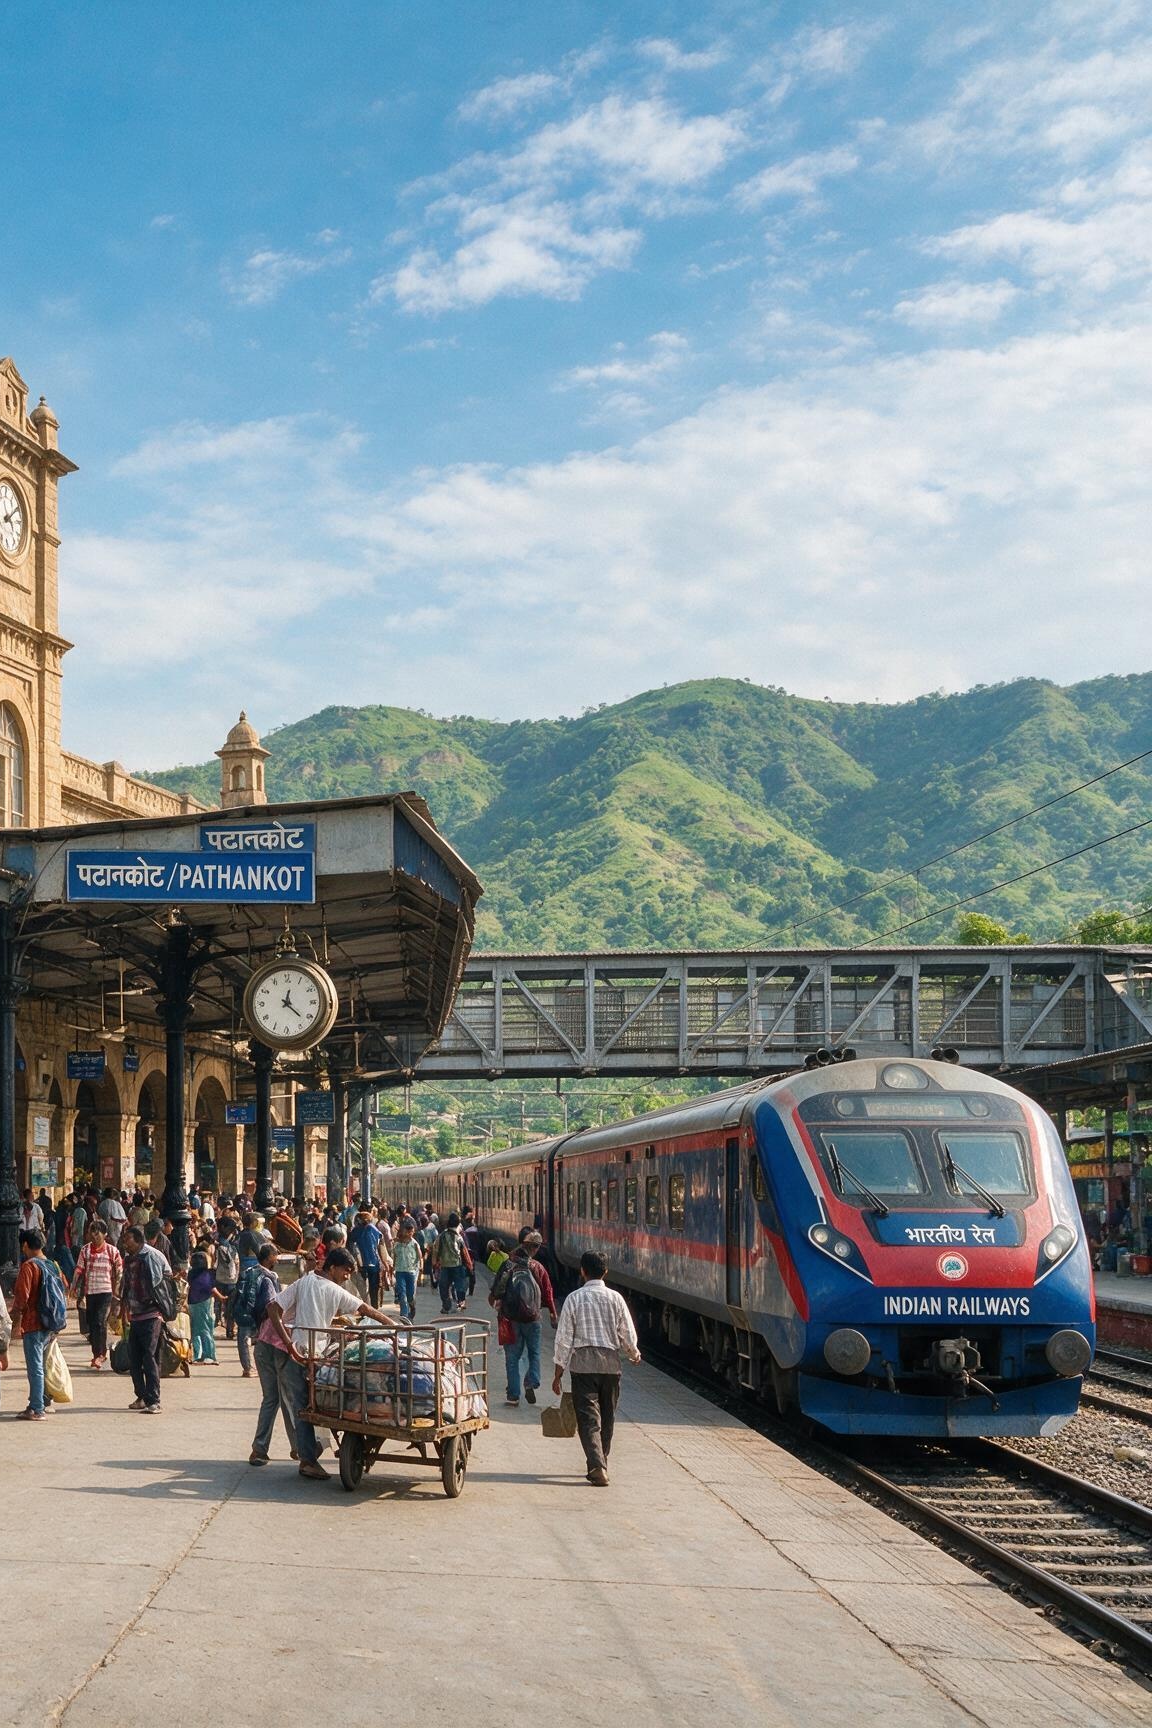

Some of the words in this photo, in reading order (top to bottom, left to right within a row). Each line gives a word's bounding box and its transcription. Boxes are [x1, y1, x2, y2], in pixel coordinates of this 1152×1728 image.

[179, 864, 305, 891] PATHANKOT
[904, 1223, 967, 1244] भारतीय
[968, 1223, 996, 1244] रेल
[884, 1296, 942, 1316] INDIAN
[947, 1296, 1030, 1317] RAILWAYS
